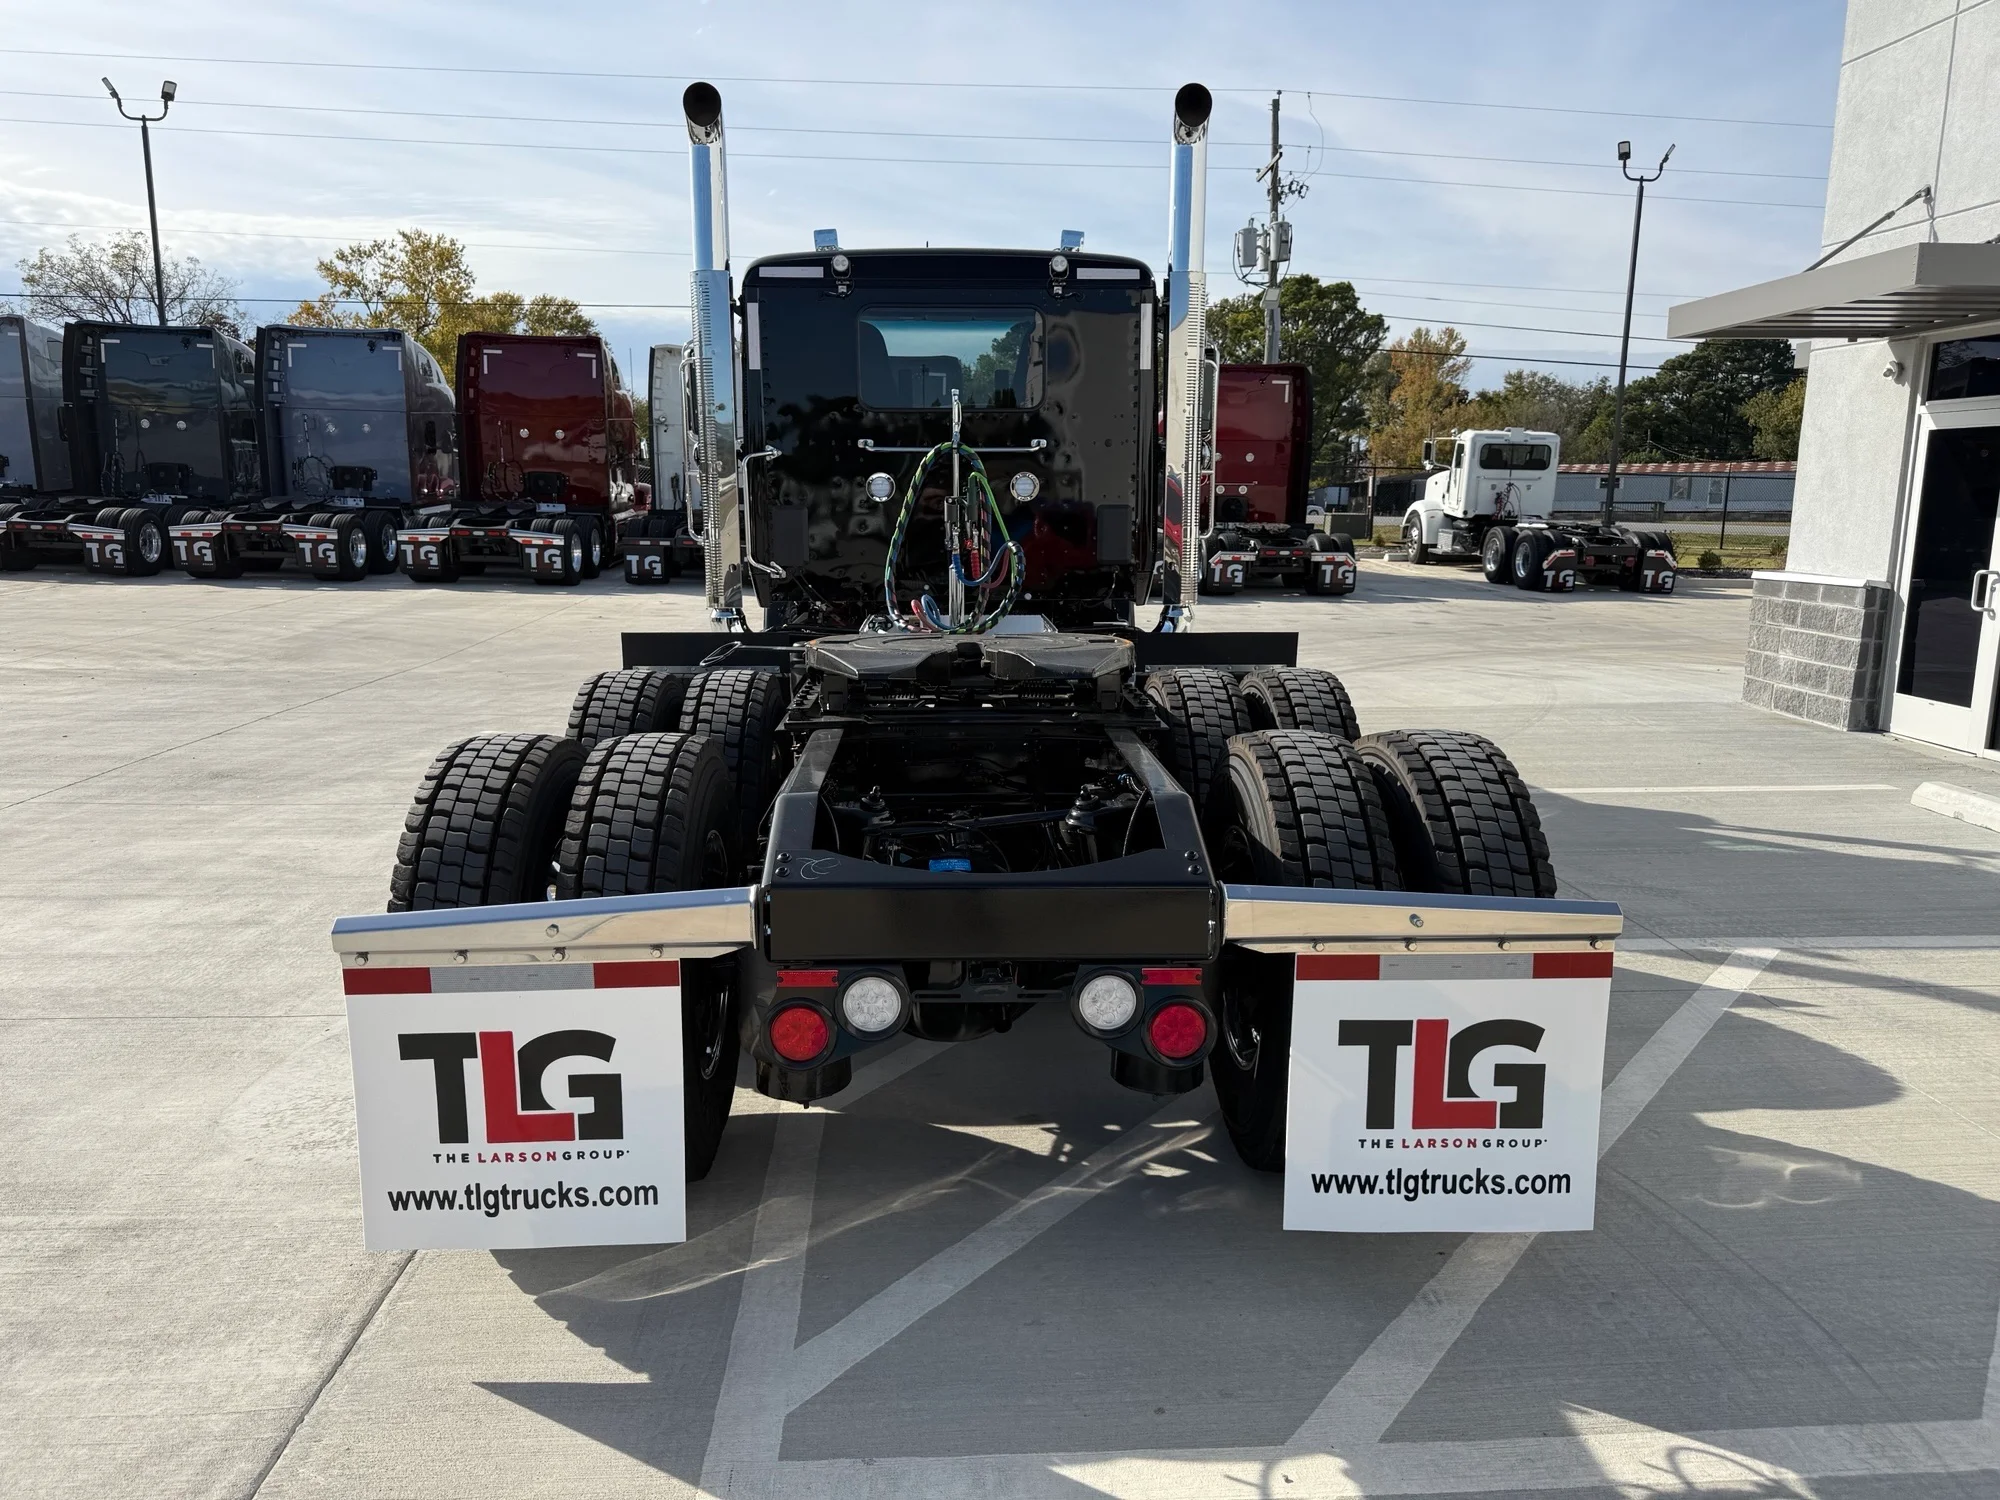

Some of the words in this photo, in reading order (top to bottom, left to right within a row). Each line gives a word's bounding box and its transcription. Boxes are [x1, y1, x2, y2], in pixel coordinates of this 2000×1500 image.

[397, 1029, 625, 1144] TLG
[1338, 1018, 1546, 1130] TLG
[433, 1153, 470, 1163] THE
[477, 1151, 557, 1163] LARSON
[562, 1150, 625, 1161] GROUP
[1358, 1138, 1394, 1149] THE
[1401, 1138, 1477, 1149] LARSON
[1482, 1138, 1543, 1149] GROUP
[387, 1180, 659, 1218] www.tlgtrucks.com
[1311, 1167, 1571, 1202] www.tlgtrucks.com
